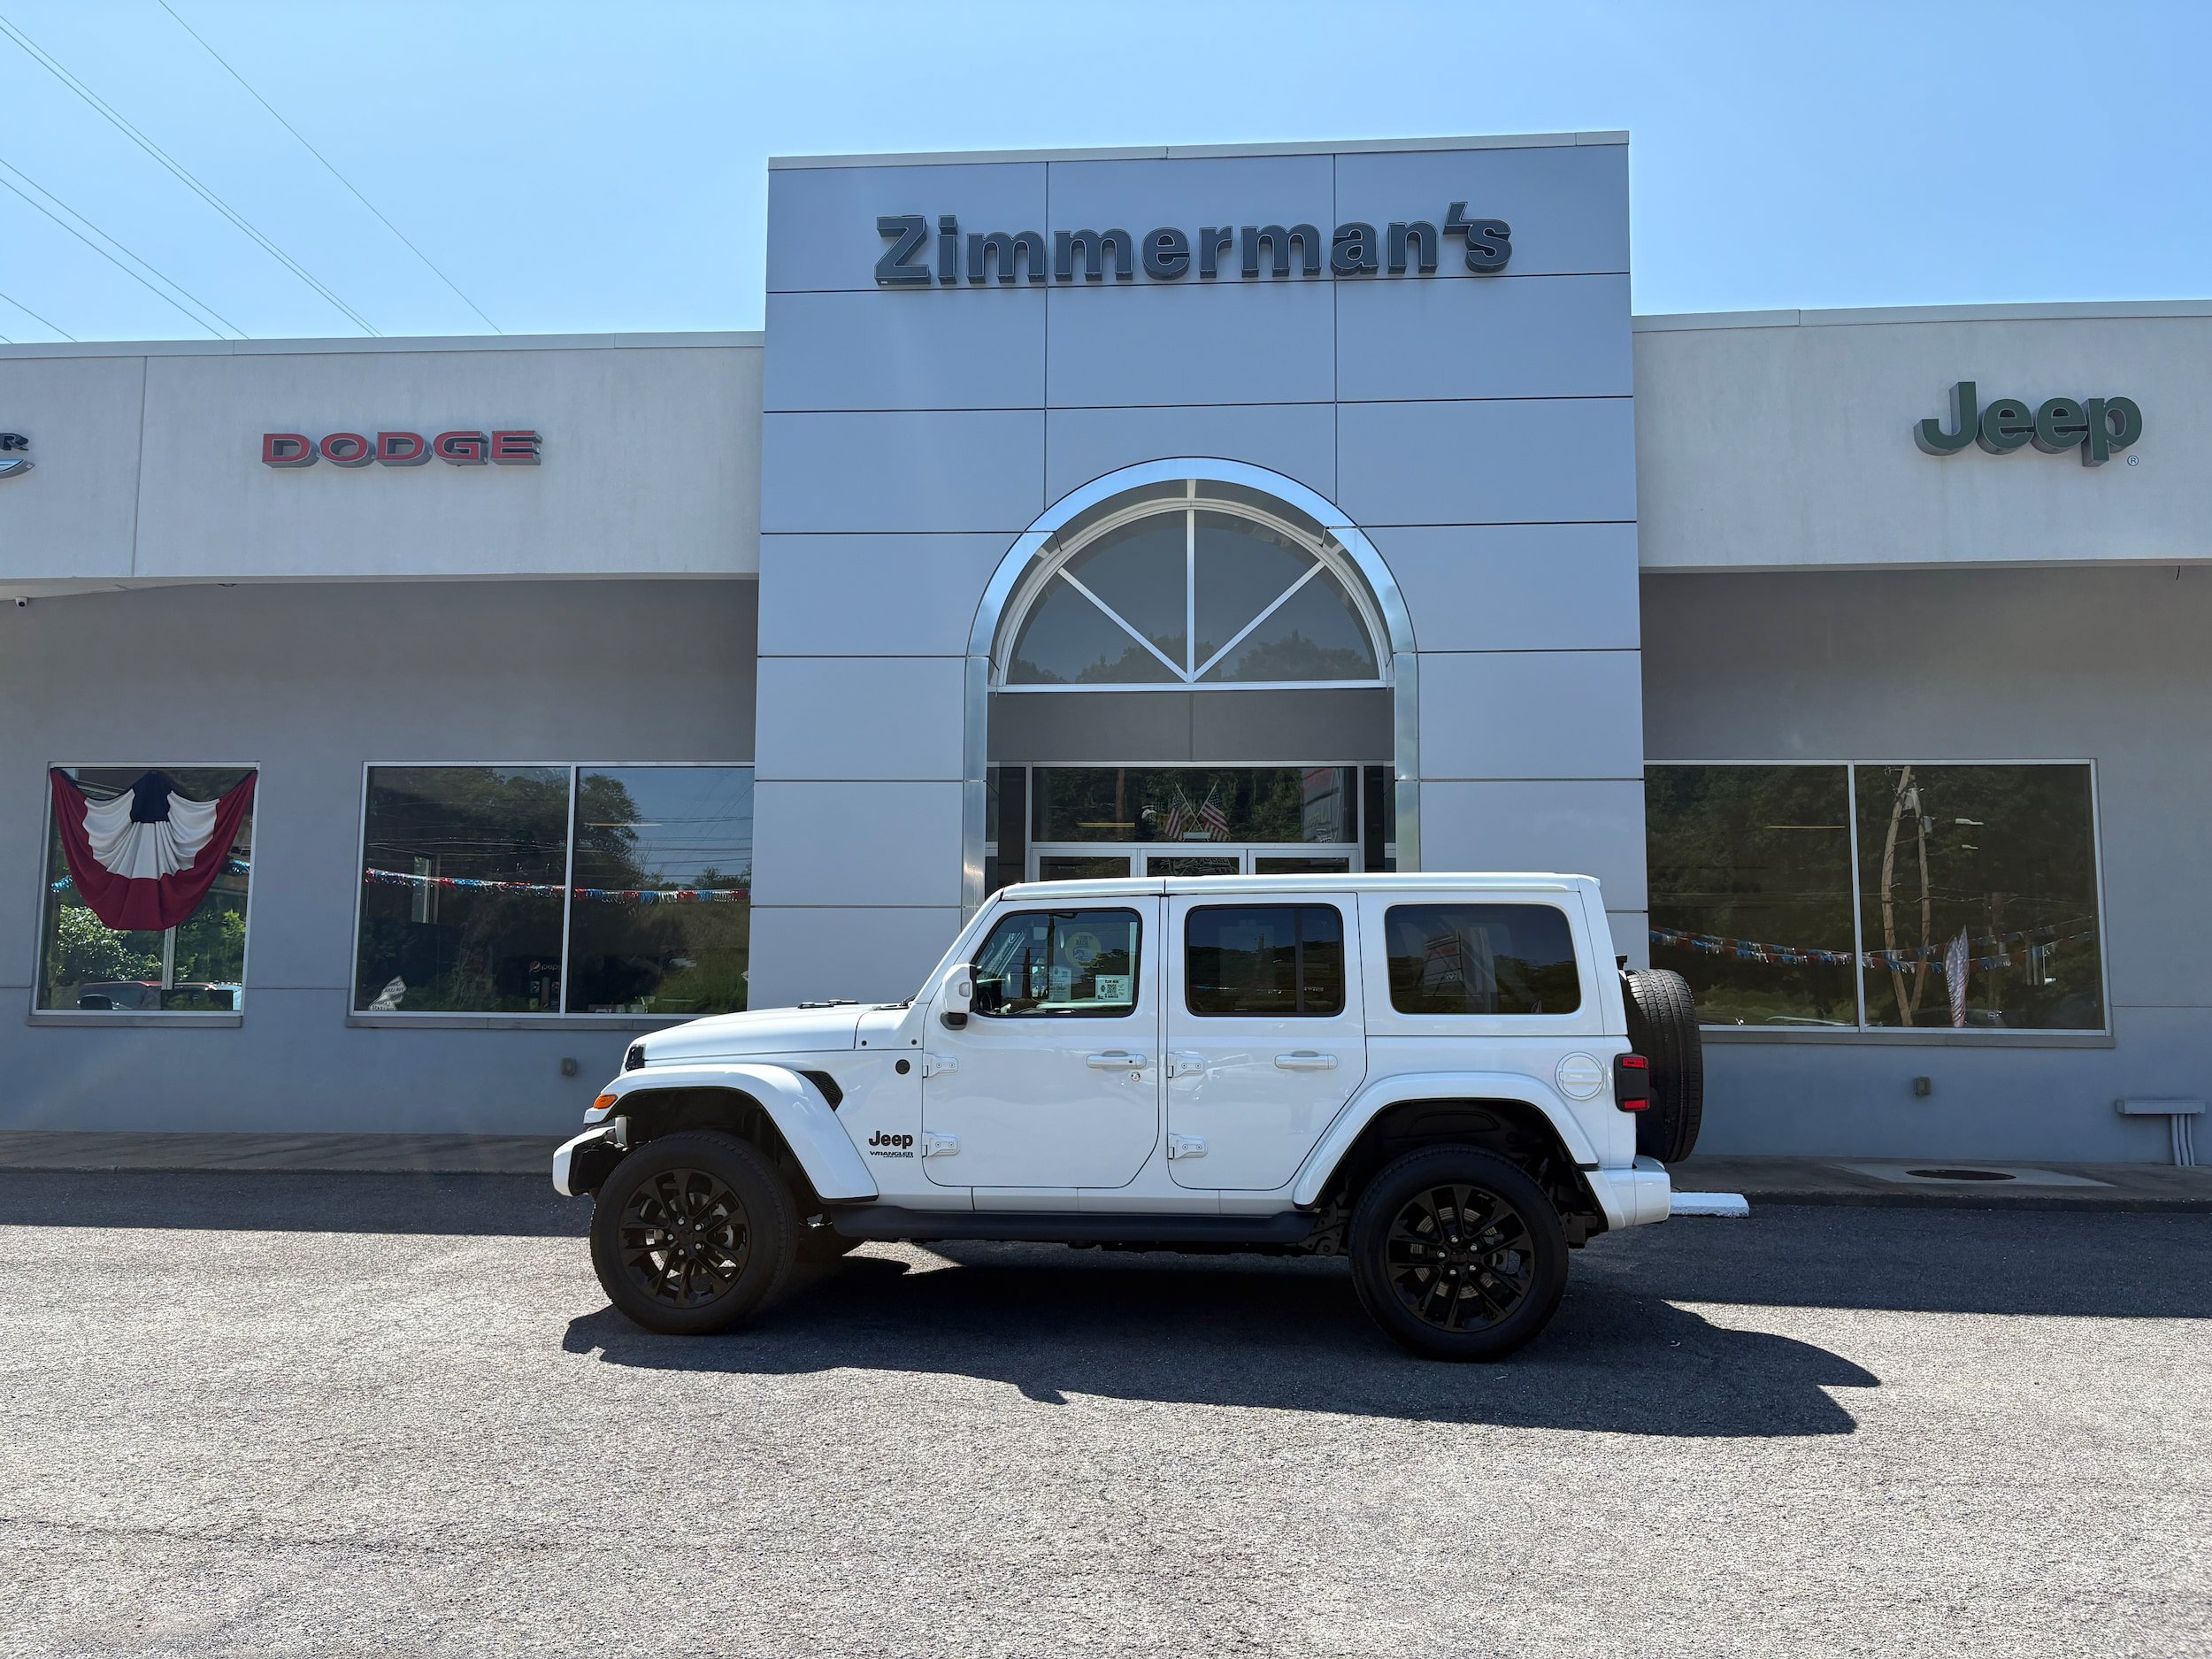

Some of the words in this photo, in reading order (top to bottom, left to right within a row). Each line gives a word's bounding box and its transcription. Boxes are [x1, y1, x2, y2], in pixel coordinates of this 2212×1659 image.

[874, 201, 1512, 285] Zimmerman's
[262, 430, 542, 468] DODGE
[1914, 381, 2142, 466] Jeep
[868, 1130, 913, 1149] Jeep
